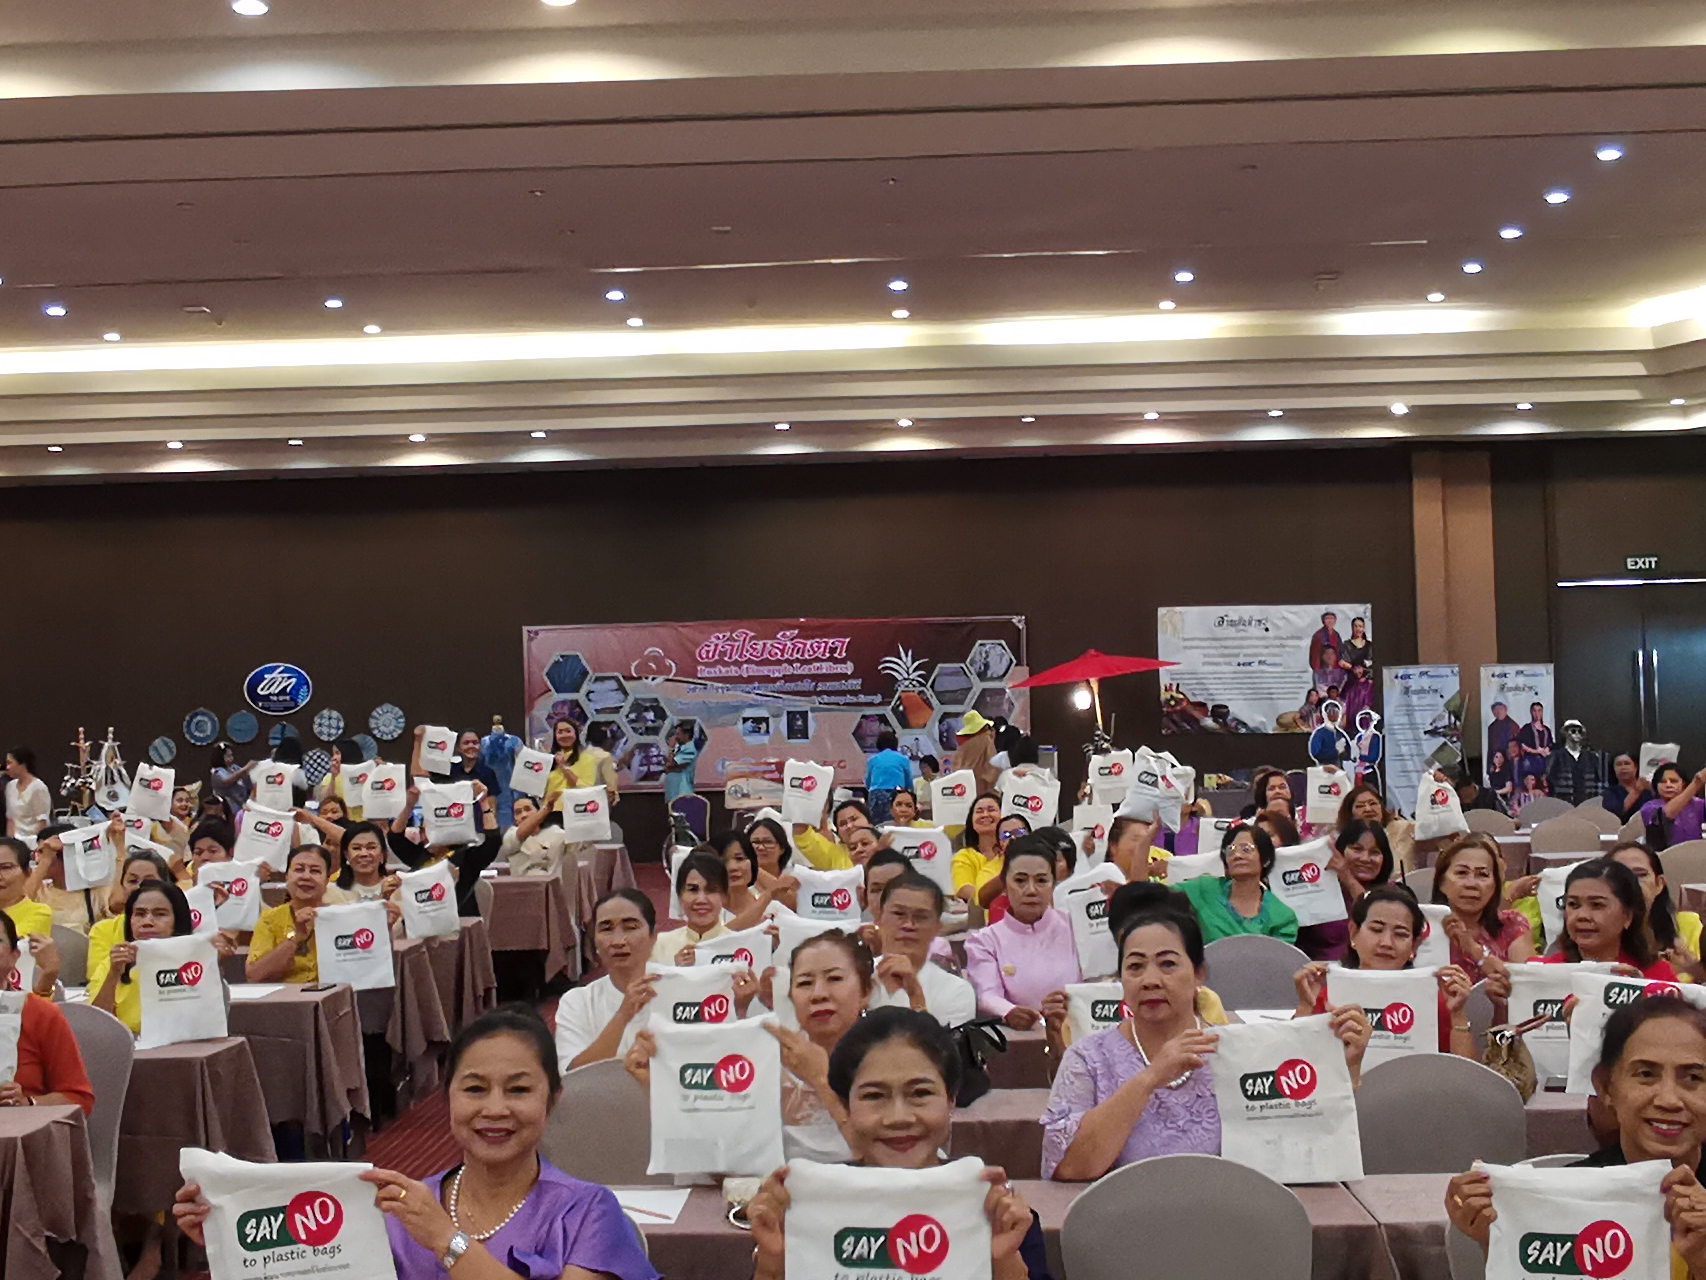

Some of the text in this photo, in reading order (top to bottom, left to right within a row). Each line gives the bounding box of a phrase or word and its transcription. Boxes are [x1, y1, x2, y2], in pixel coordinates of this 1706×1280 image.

[1626, 557, 1658, 570] EXIT
[833, 890, 850, 908] NO
[355, 930, 373, 947] NO
[182, 964, 201, 982] NO
[1608, 988, 1641, 1004] SAY
[675, 997, 726, 1020] SAY NO
[1094, 1003, 1119, 1018] SAY
[1386, 1007, 1410, 1028] NO
[684, 1060, 750, 1087] SAY NO
[1245, 1064, 1311, 1096] SAY NO
[1260, 1101, 1291, 1113] plastic
[244, 1197, 336, 1243] SAY NO
[841, 1223, 941, 1266] SAY NO
[1527, 1228, 1626, 1271] SAY NO
[243, 1243, 342, 1271] to plastic bags
